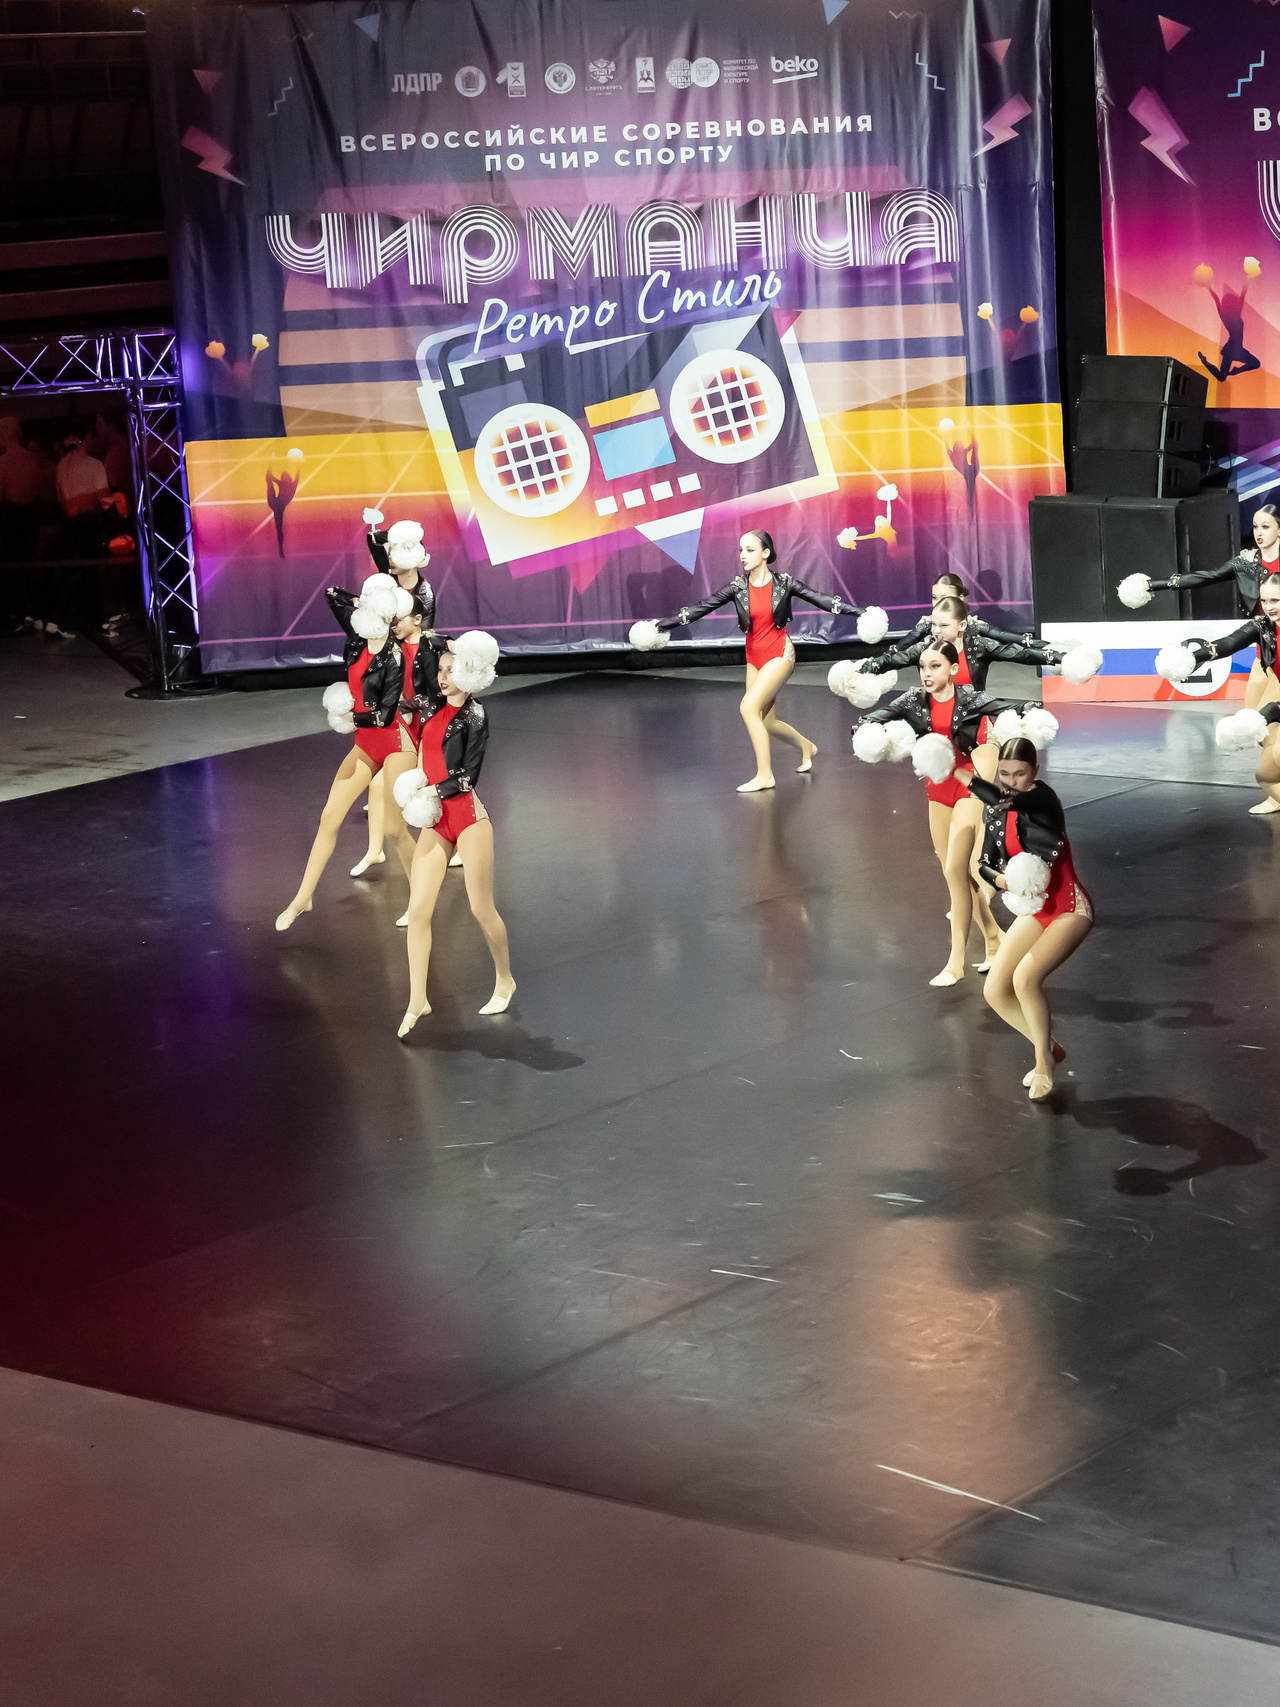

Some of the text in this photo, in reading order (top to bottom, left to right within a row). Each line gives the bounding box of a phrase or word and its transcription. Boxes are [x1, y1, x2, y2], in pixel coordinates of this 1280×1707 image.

[770, 55, 819, 74] beko
[391, 72, 443, 95] ЛДПР
[340, 114, 873, 152] ВСЕРОССИЙСКИЕ СОРЕВНОВАНИЯ
[484, 144, 734, 172] ПО ЧИР СПОРТУ
[473, 269, 783, 354] Ретро Стиль
[1180, 637, 1213, 684] 2
